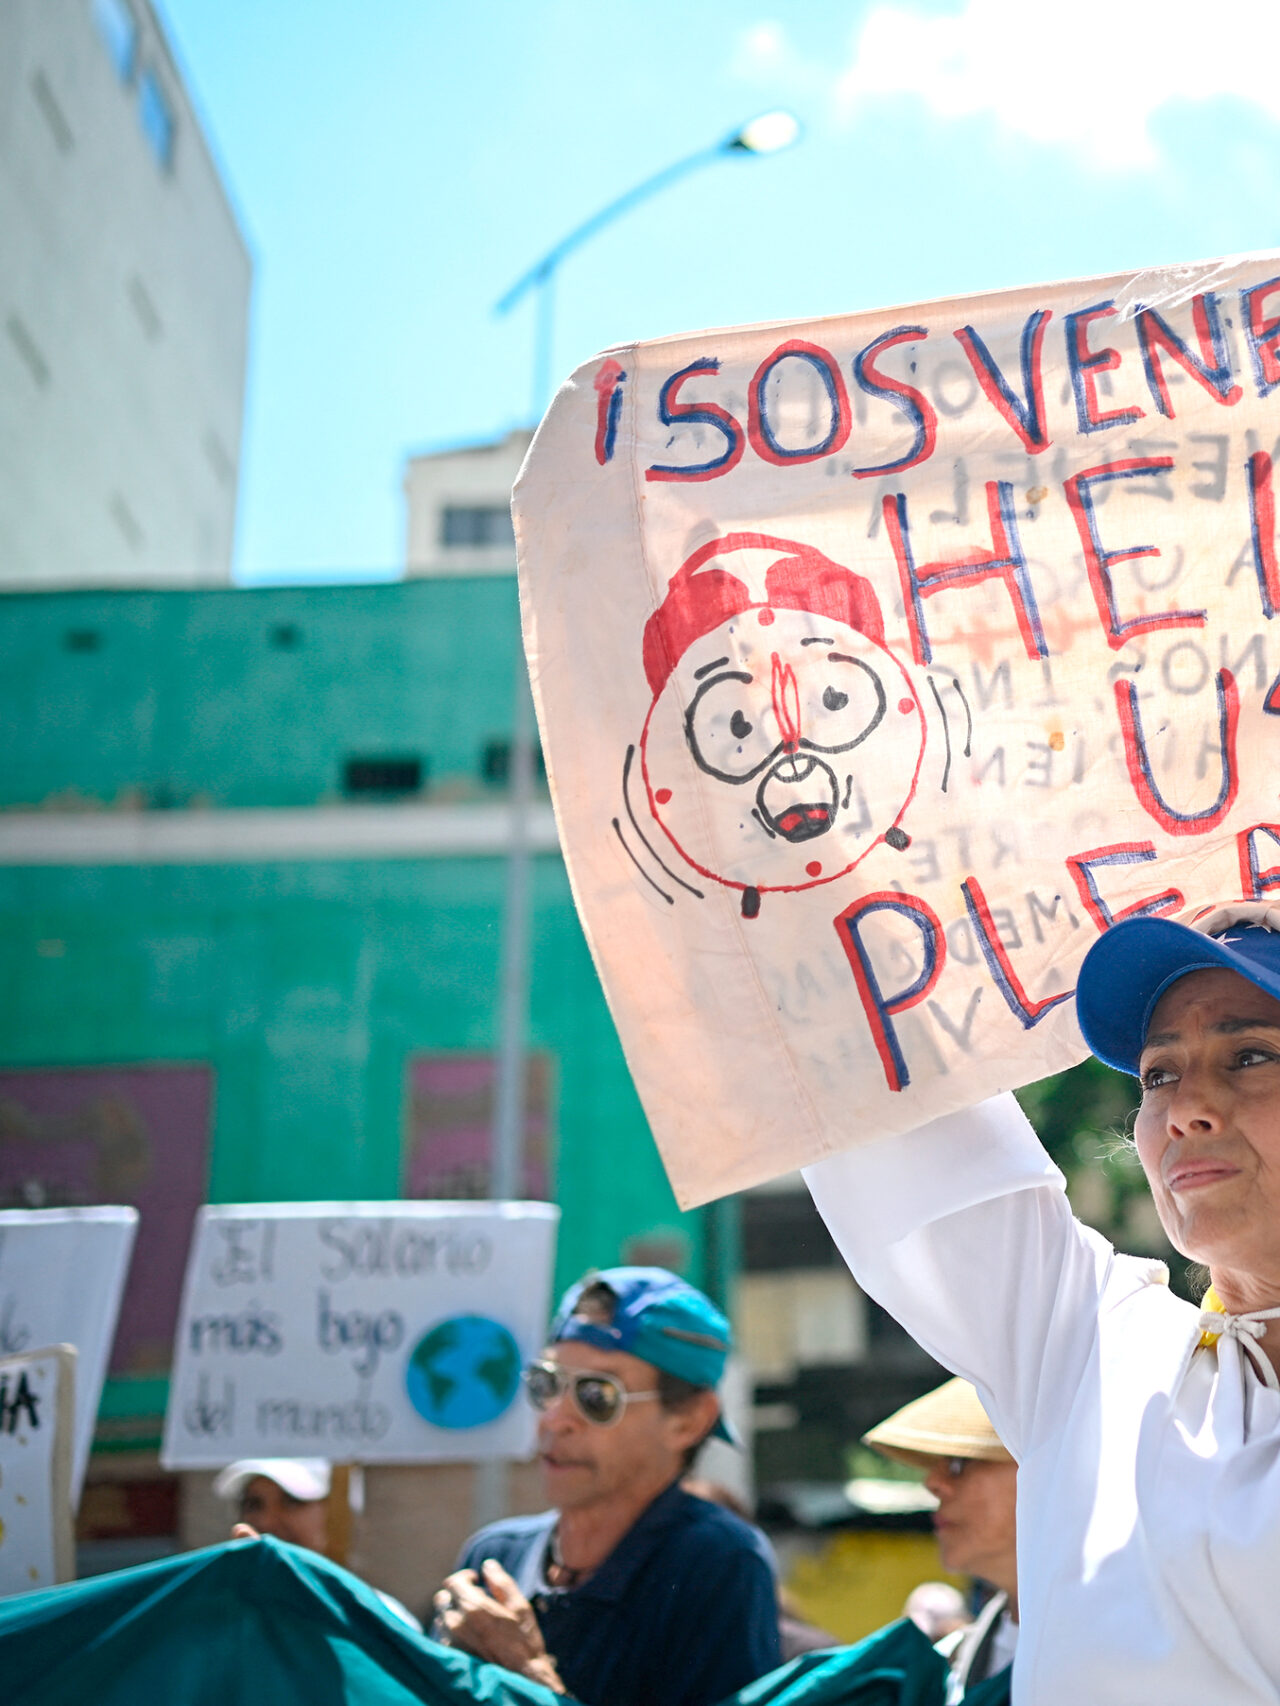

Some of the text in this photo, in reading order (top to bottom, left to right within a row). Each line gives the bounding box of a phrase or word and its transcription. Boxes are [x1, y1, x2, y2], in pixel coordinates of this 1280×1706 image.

[317, 1288, 405, 1380] bajo
[183, 1370, 395, 1443] del mundo
